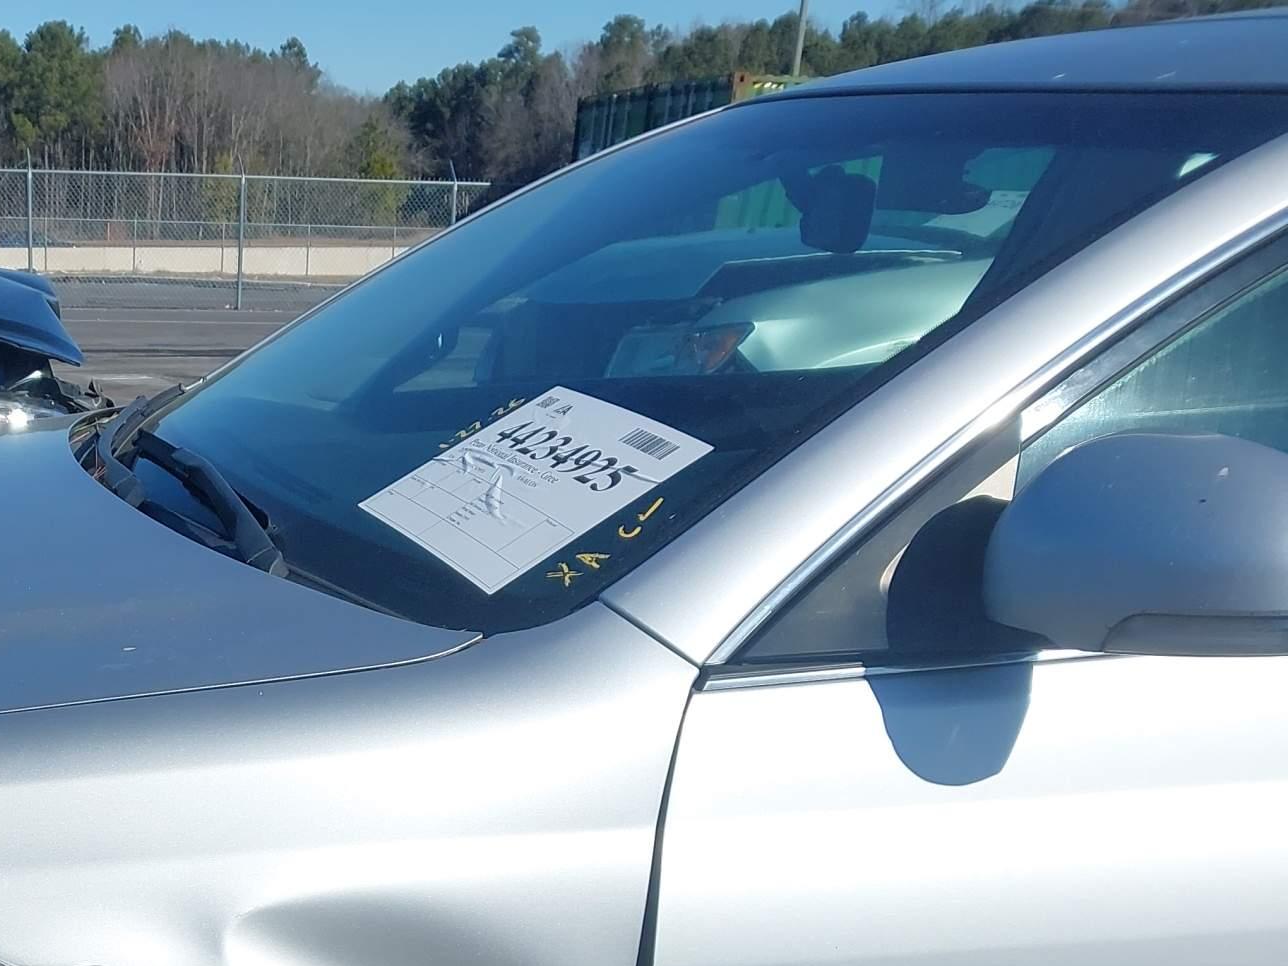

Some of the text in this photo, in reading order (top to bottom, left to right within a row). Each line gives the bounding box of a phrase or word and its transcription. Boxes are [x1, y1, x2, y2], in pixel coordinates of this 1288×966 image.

[486, 443, 512, 461] National
[507, 454, 539, 474] Insurance
[495, 421, 639, 491] 44234925
